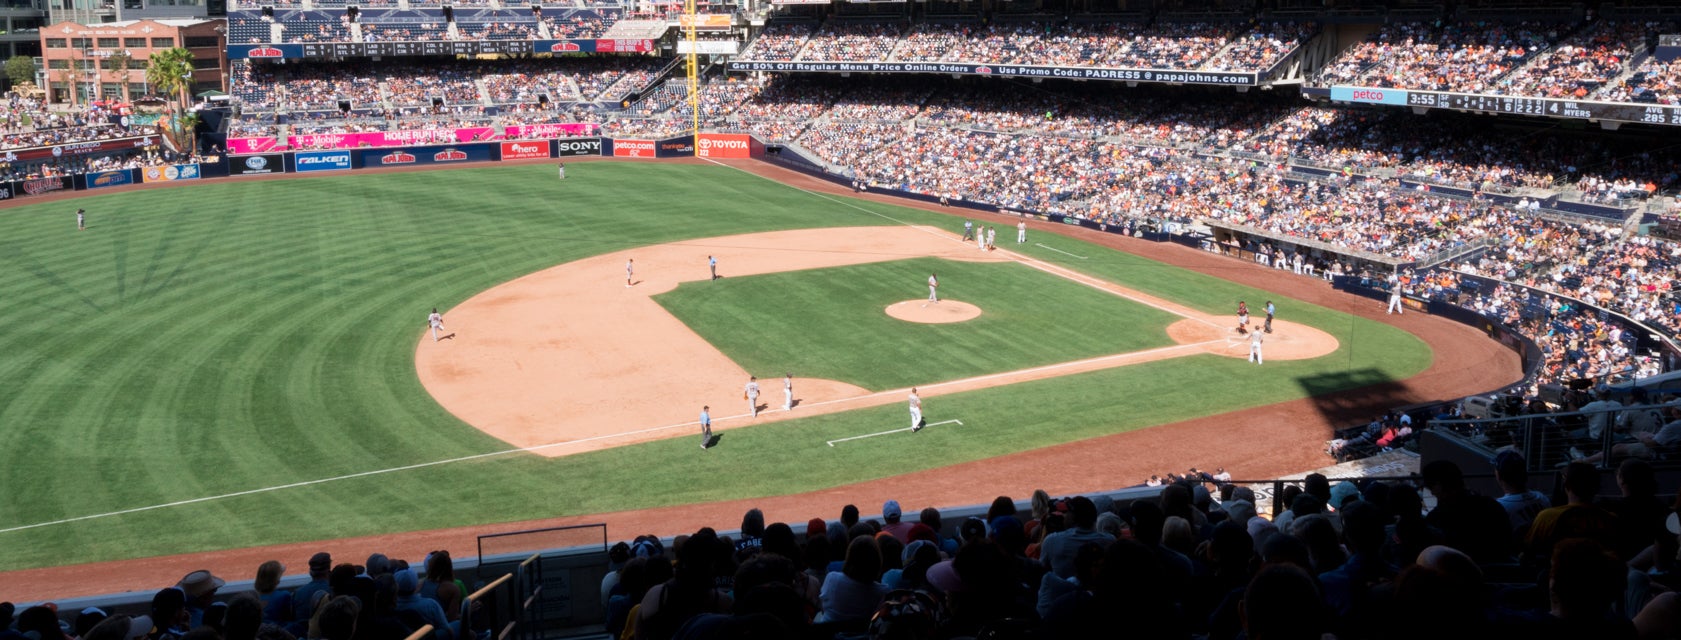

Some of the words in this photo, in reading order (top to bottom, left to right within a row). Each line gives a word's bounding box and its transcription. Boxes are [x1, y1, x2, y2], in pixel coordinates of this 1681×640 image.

[796, 63, 836, 72] Regular
[939, 64, 969, 72] Orders
[1019, 67, 1051, 75] Promo
[1053, 68, 1082, 77] Code:
[1085, 69, 1140, 79] PADRES5
[1144, 72, 1152, 80] @
[1156, 73, 1249, 85] papajohns.com
[1353, 89, 1384, 100] petco
[1410, 93, 1435, 104] 3:55
[1505, 103, 1511, 111] 6
[1517, 104, 1523, 113] 2
[1526, 105, 1532, 113] 2
[1535, 105, 1542, 113] 2
[1549, 102, 1559, 113] 4
[1645, 106, 1662, 114] AVG
[1564, 109, 1591, 118] MYERS
[1641, 113, 1665, 123] .285
[1671, 115, 1681, 124] 2
[384, 130, 412, 141] HOME
[412, 129, 432, 140] RUN
[518, 145, 538, 153] hero
[560, 141, 601, 151] SONY
[615, 142, 654, 151] petco.com
[712, 140, 748, 149] TOYOTA
[298, 155, 349, 164] FALKEN
